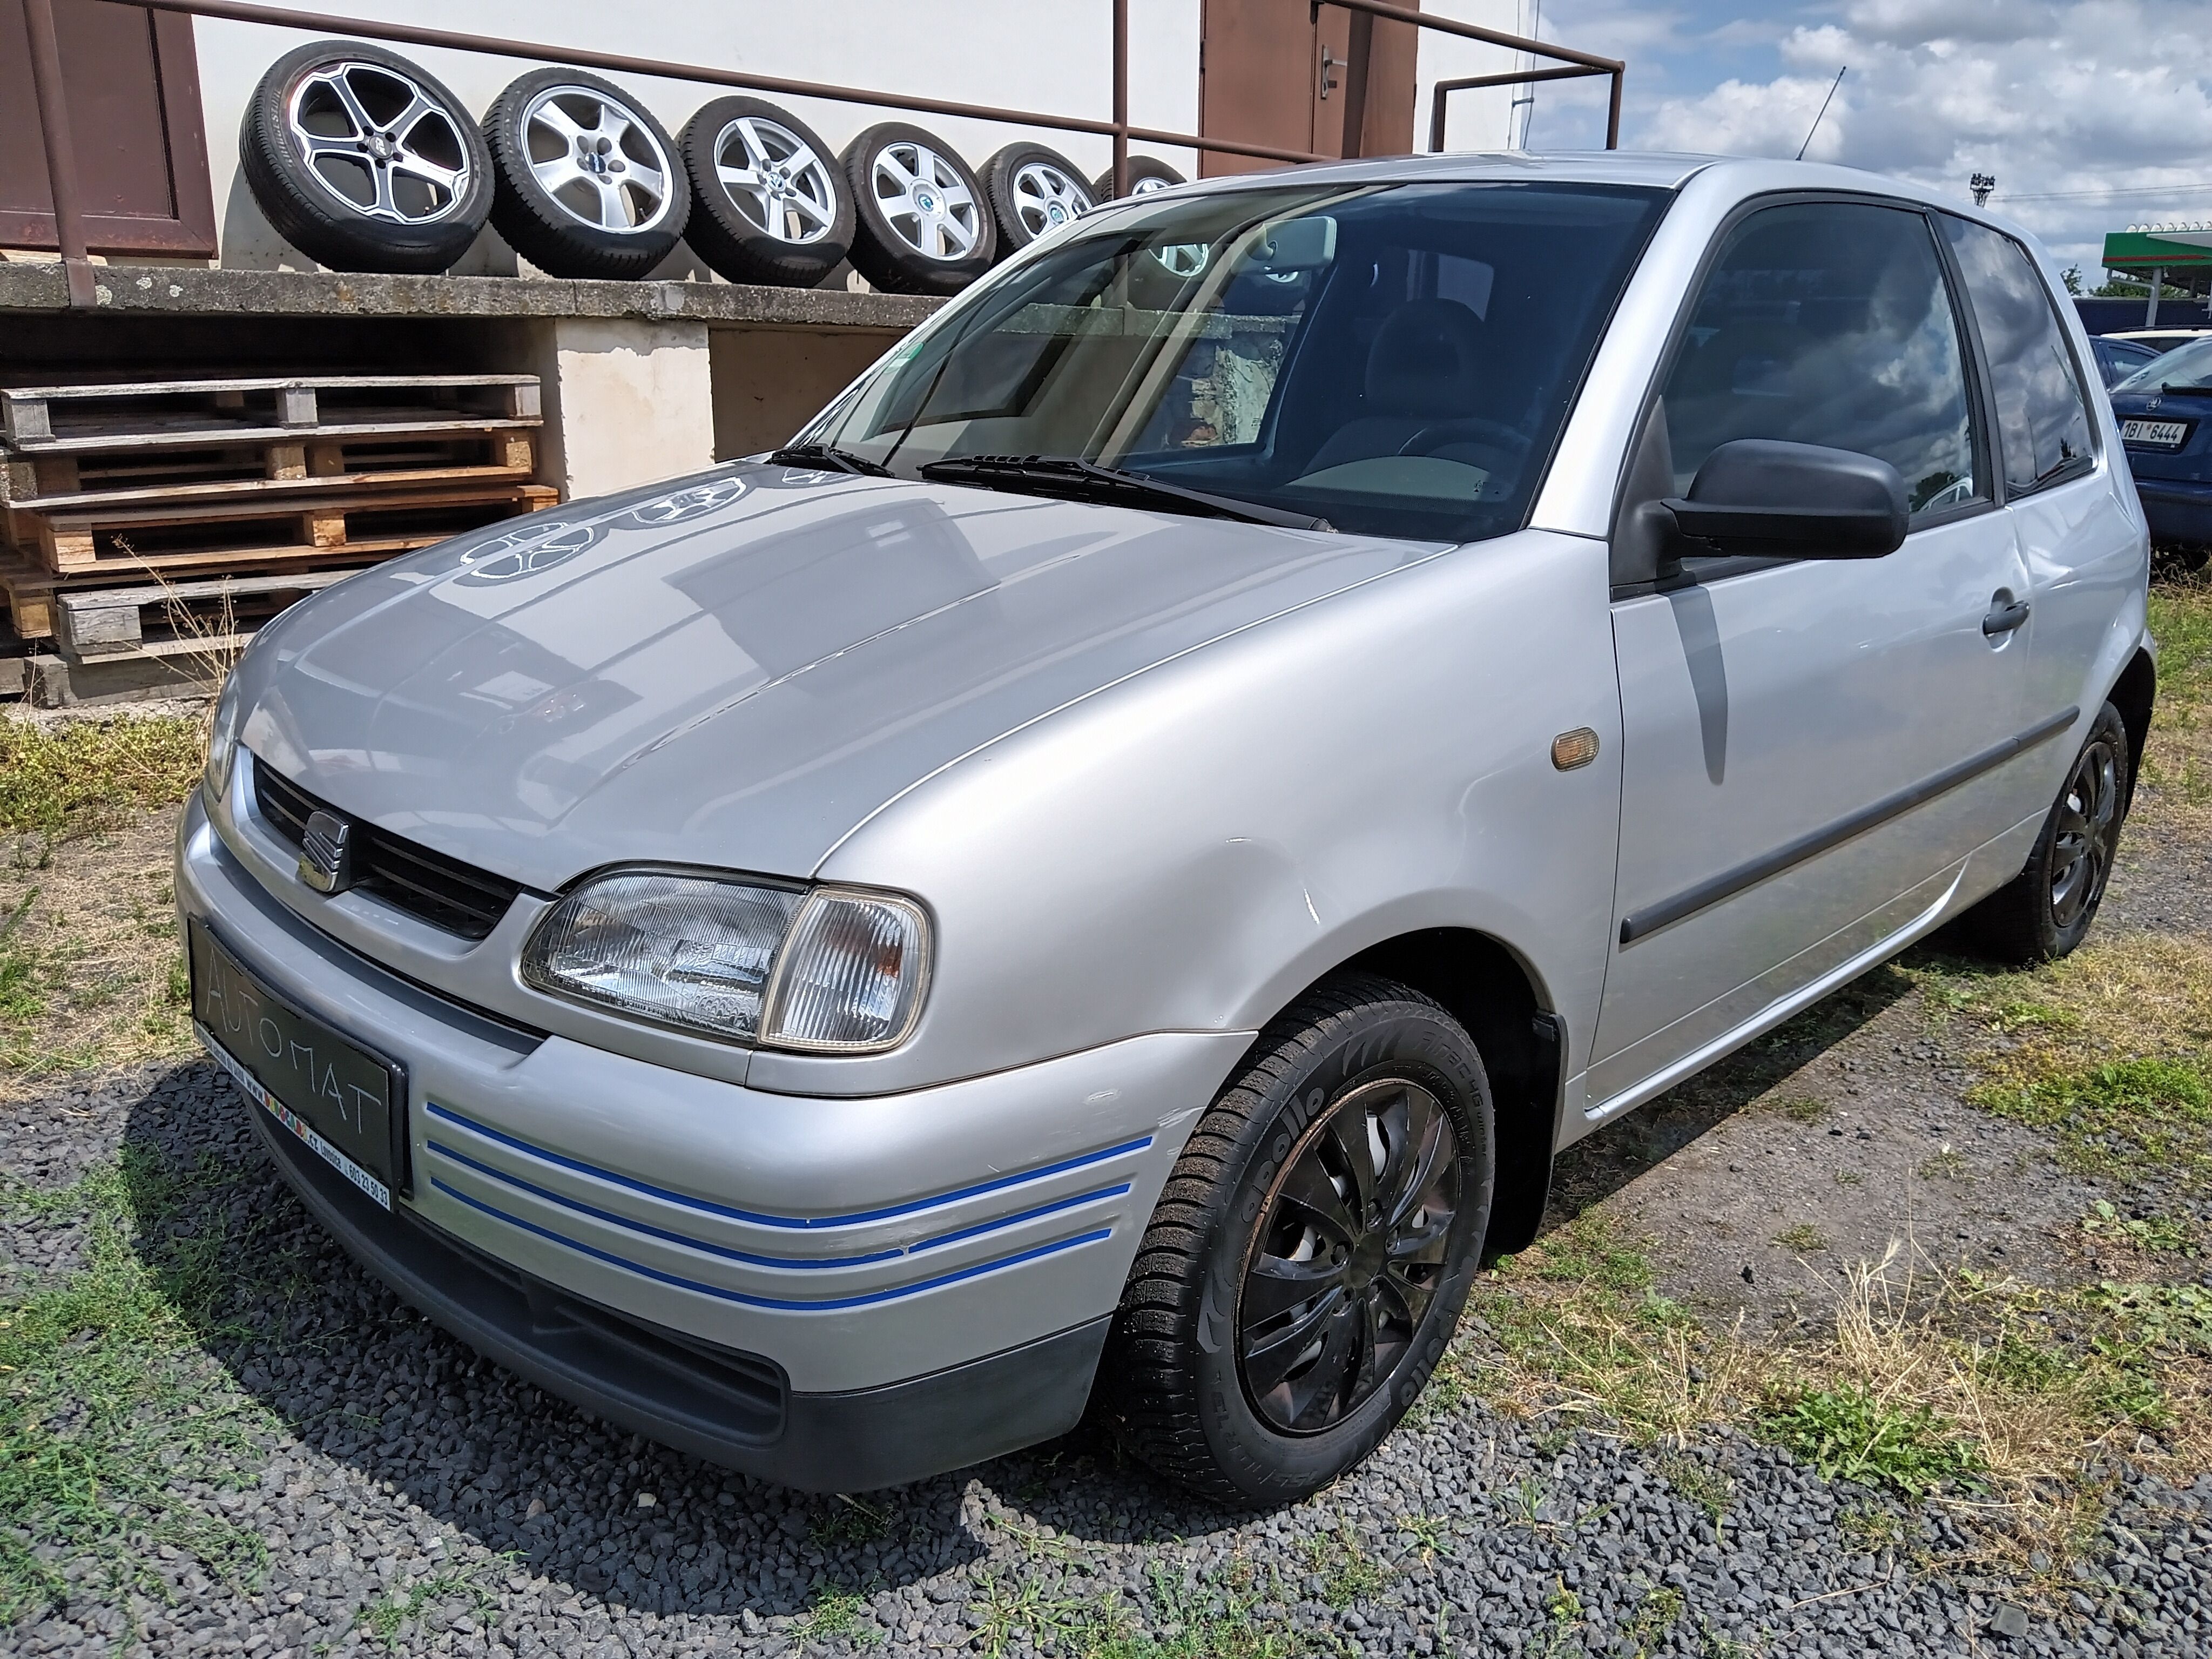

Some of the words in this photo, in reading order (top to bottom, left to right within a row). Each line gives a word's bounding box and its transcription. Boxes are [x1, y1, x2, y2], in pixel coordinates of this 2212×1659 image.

[2149, 424, 2180, 441] 6444
[206, 946, 382, 1135] AUTOMAT
[349, 1164, 361, 1184] 603
[361, 1174, 369, 1191] 23
[370, 1182, 379, 1198] 50
[380, 1188, 388, 1206] 33
[1242, 1087, 1325, 1223] apollo
